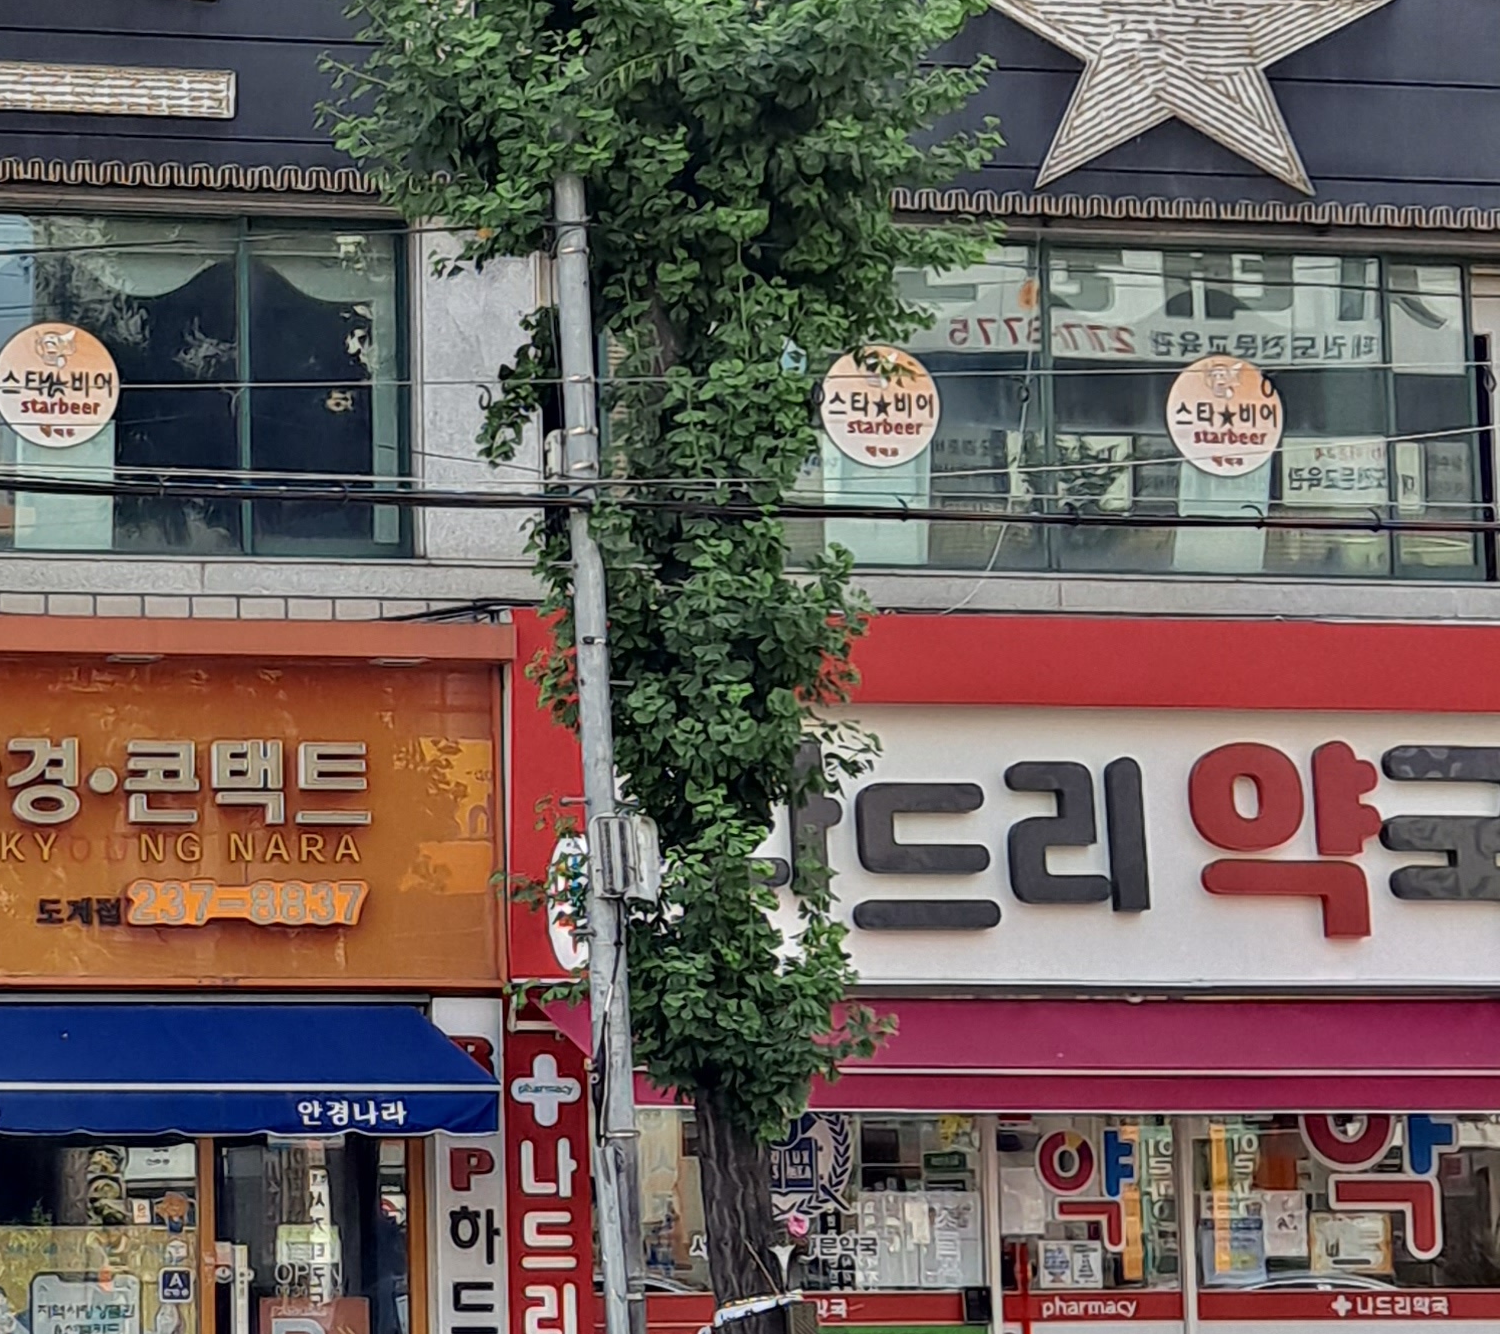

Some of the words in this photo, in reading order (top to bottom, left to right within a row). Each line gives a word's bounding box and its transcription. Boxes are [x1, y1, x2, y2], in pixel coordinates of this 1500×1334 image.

[21, 398, 101, 415] starbeer
[847, 418, 923, 435] starbeer
[1194, 429, 1268, 445] starbeer
[229, 831, 362, 863] NARA
[36, 896, 127, 925] 도계점
[130, 881, 368, 925] 237-8837
[297, 1099, 407, 1127] 안경나라
[1038, 1130, 1134, 1252] 약
[1041, 1296, 1138, 1319] pharmacy
[1356, 1297, 1449, 1316] 나드리약국
